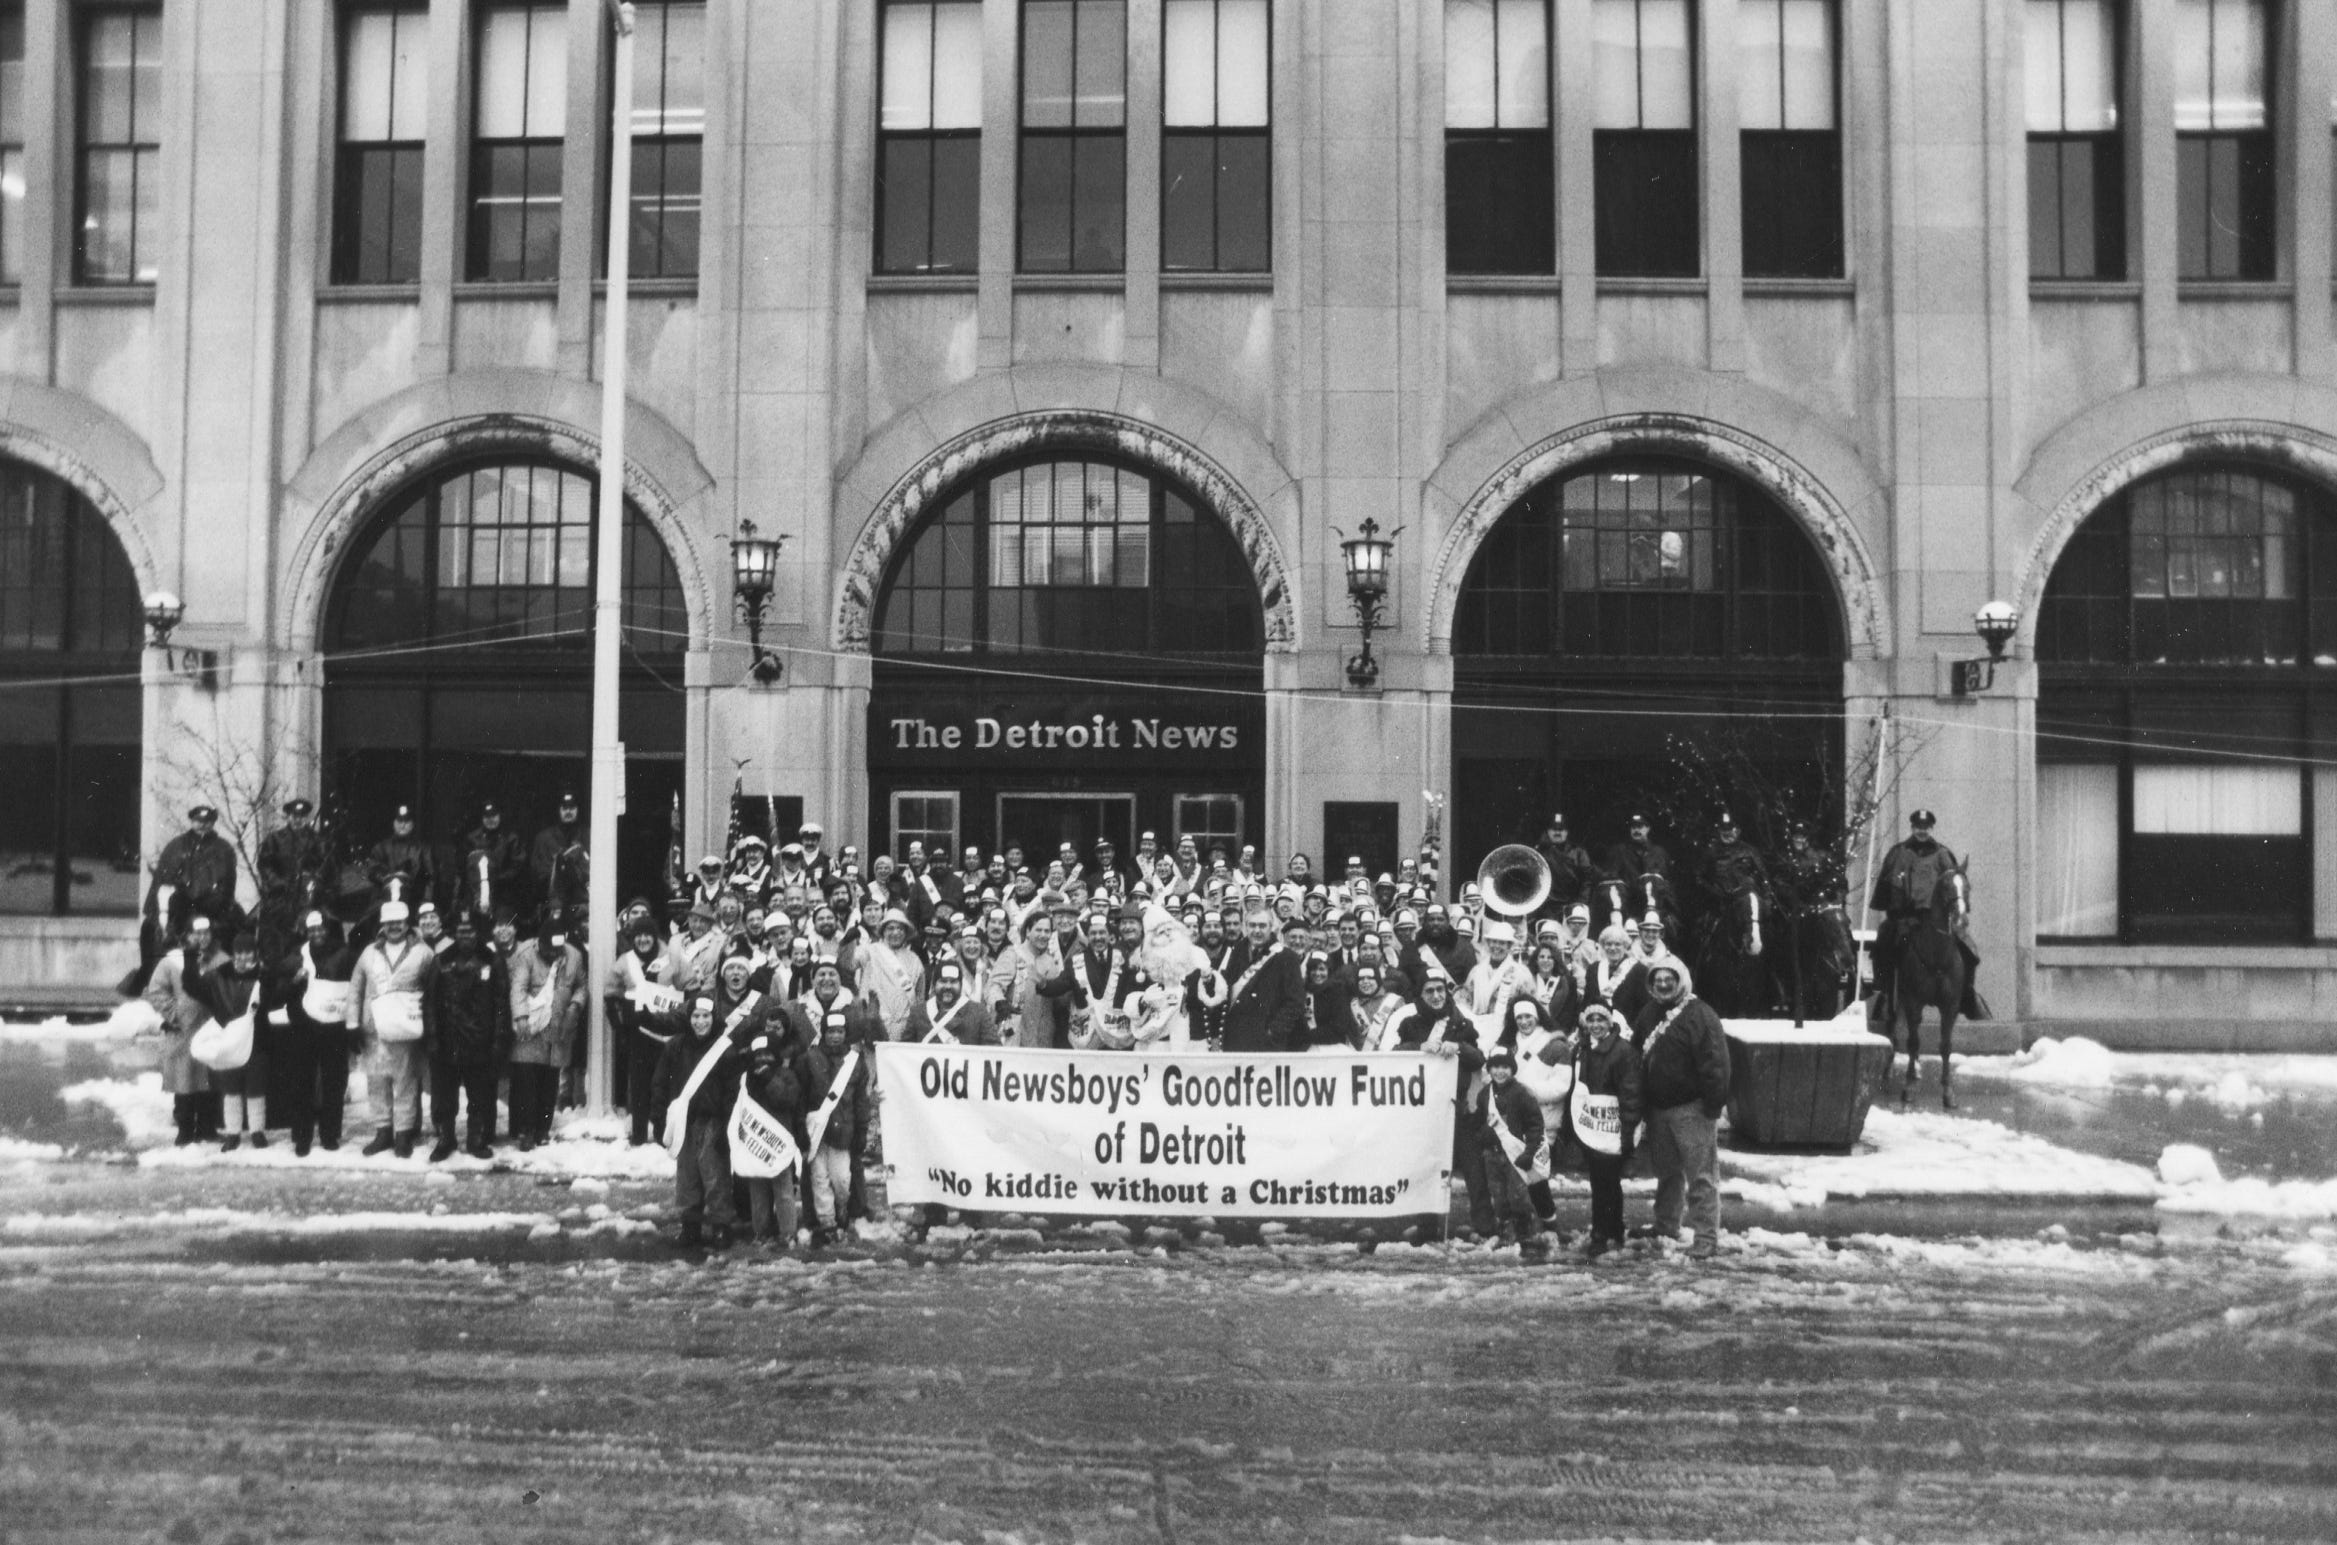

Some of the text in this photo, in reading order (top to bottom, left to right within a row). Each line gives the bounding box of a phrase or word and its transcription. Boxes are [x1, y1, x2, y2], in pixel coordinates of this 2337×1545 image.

[890, 714, 1239, 749] The Detroit News
[920, 1057, 969, 1100] Old
[1162, 1064, 1337, 1107] Goodfellow
[1351, 1064, 1425, 1107] Fund
[746, 1136, 776, 1167] FELLOWS
[750, 1119, 787, 1154] NEWSBOYS
[1094, 1121, 1246, 1165] of Detroit
[985, 1172, 1078, 1199] kiddie
[1091, 1177, 1209, 1204] without
[1221, 1184, 1237, 1204] a
